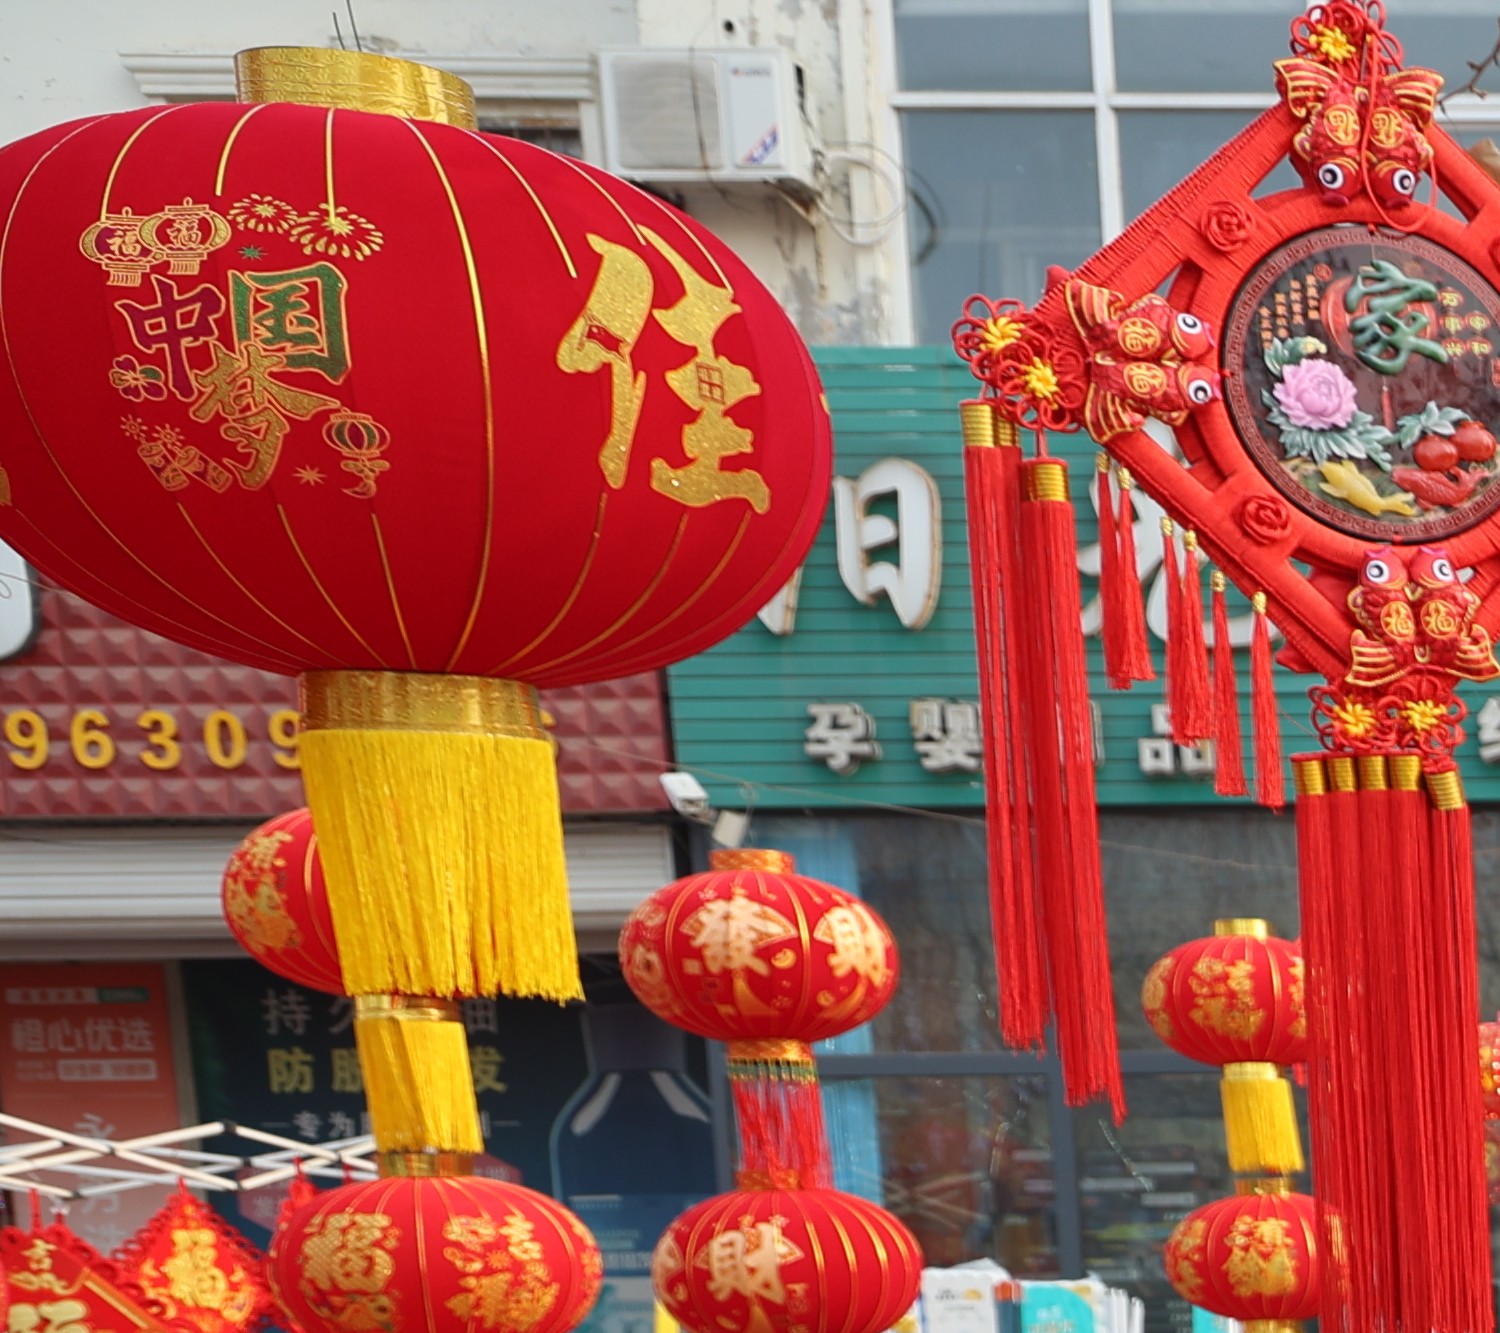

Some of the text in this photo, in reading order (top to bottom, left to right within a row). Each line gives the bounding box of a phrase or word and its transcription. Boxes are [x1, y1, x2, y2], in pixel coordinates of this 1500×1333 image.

[117, 261, 352, 493] 中国梦
[555, 225, 774, 516] 佳
